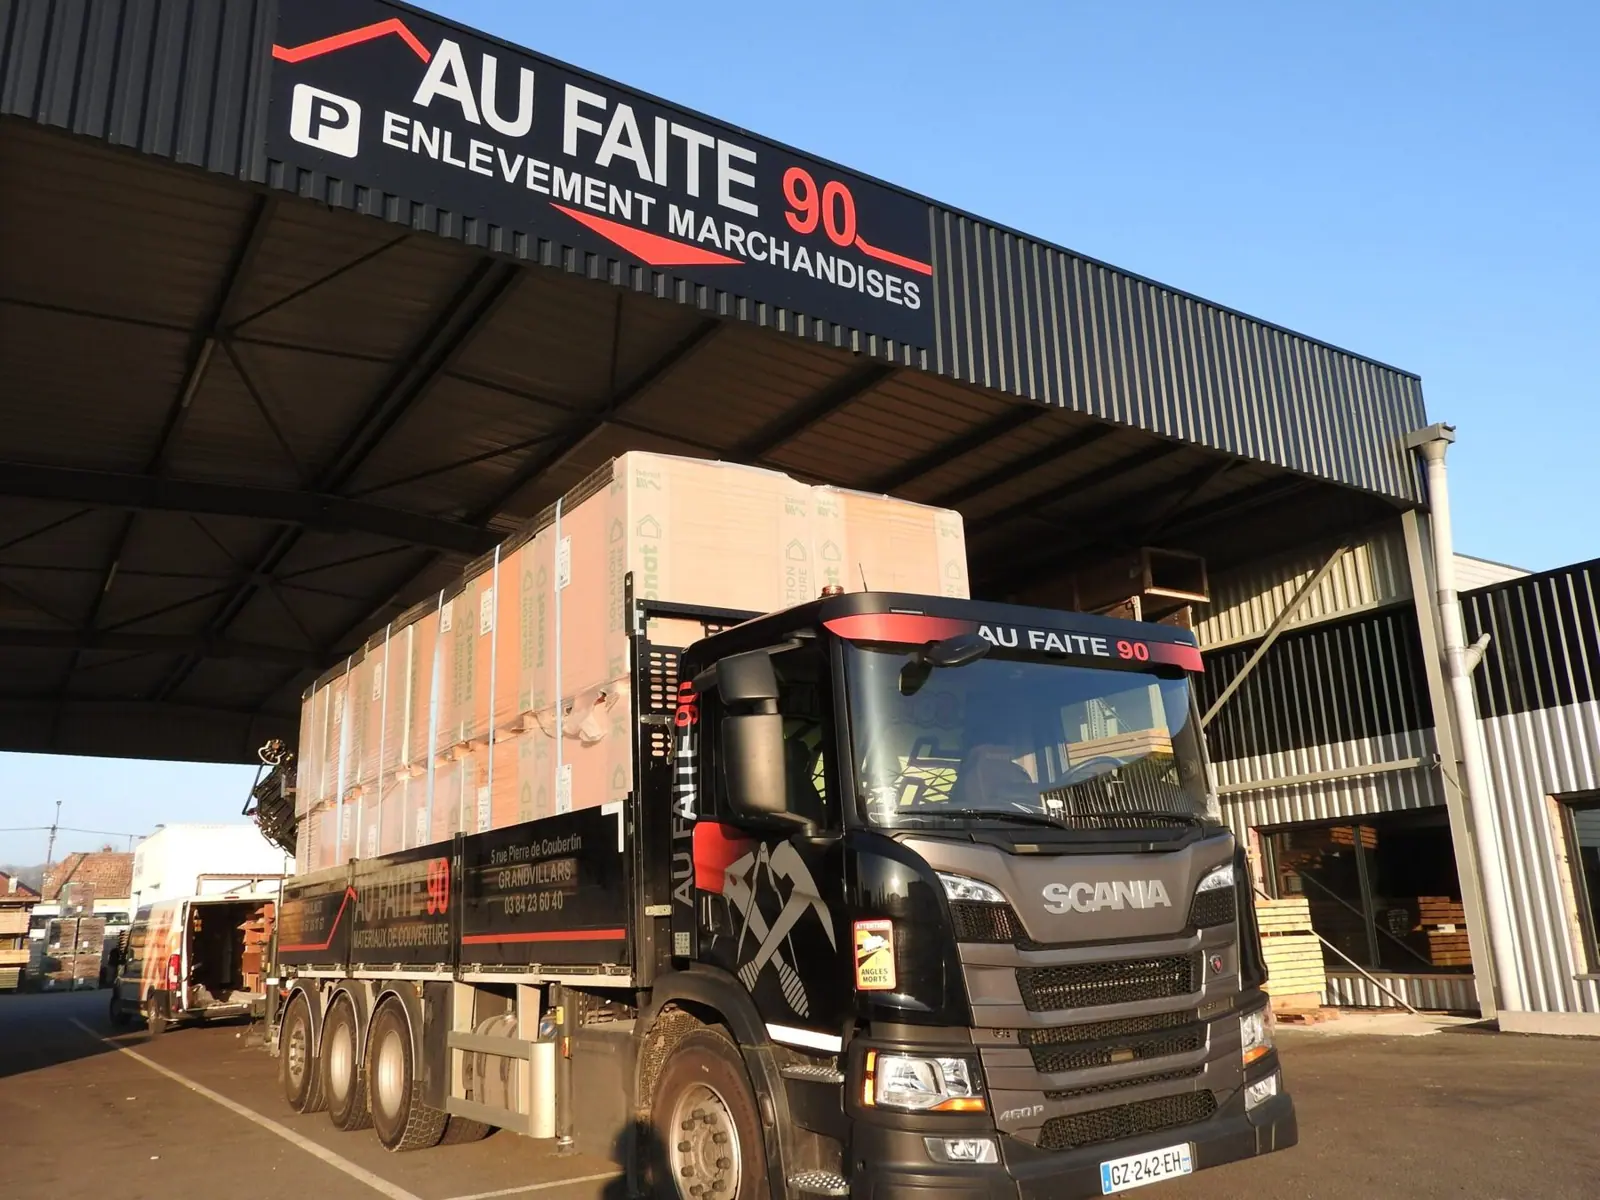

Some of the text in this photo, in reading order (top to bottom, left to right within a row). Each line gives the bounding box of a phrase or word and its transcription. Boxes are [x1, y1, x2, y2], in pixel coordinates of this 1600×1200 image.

[412, 38, 857, 247] AU FAITE 90
[381, 109, 922, 311] ENLEVEMENT MARCHANDISES
[978, 624, 1149, 662] AU FAITE 90
[672, 732, 698, 840] FAITE
[496, 848, 508, 863] rue
[508, 844, 530, 861] Pierre
[530, 840, 541, 857] de
[541, 832, 582, 855] Coubertin
[427, 857, 450, 916] 90
[498, 861, 572, 890] GRANDVILLARS
[673, 852, 694, 908] AU
[504, 890, 564, 915] 03 84 23 60 40
[1042, 879, 1172, 914] SCANIA
[388, 927, 398, 948] DE
[398, 923, 449, 948] COUVERTURE
[861, 968, 888, 976] ANGLES
[862, 975, 888, 983] MORTS
